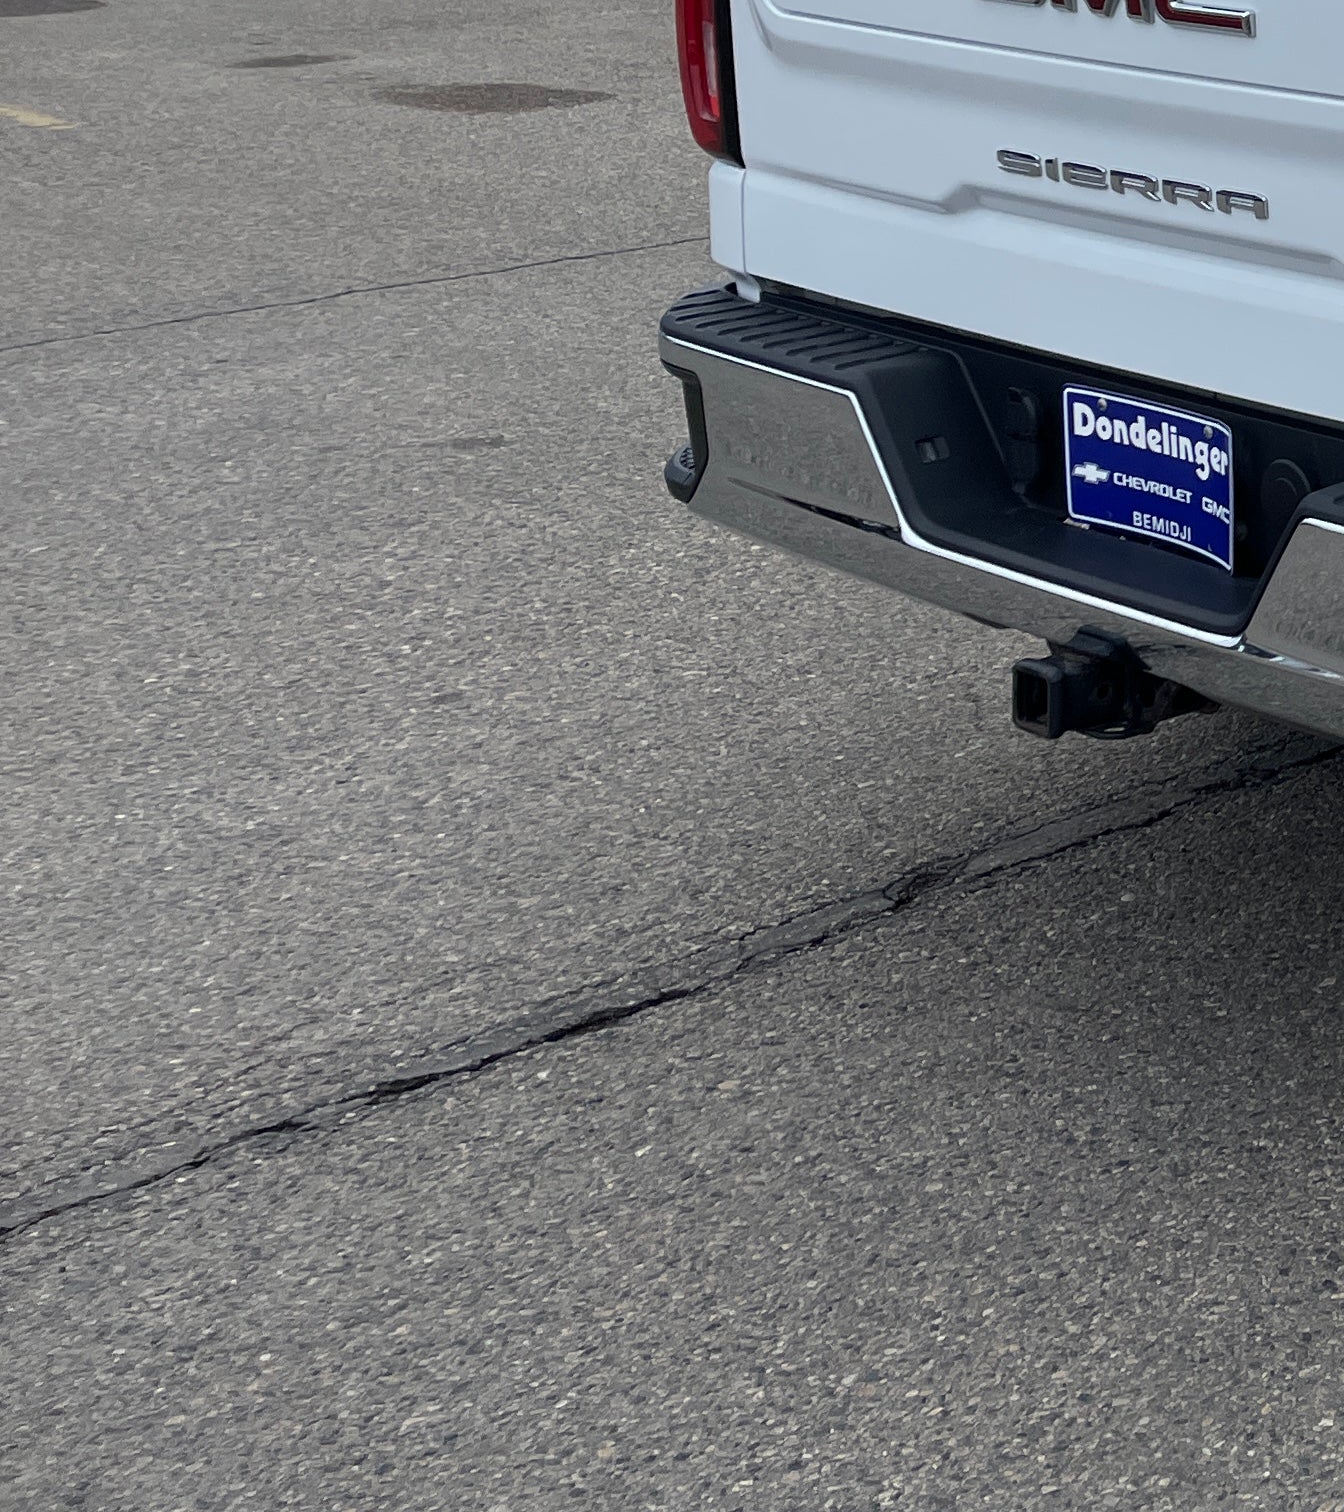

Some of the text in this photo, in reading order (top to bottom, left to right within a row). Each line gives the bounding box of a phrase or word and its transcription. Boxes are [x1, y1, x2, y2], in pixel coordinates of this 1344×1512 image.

[996, 149, 1269, 220] SIERRA
[1072, 401, 1229, 481] Dondelinger
[1112, 472, 1230, 525] CHEVROLET GMC
[1131, 510, 1192, 542] BEMIDJI
